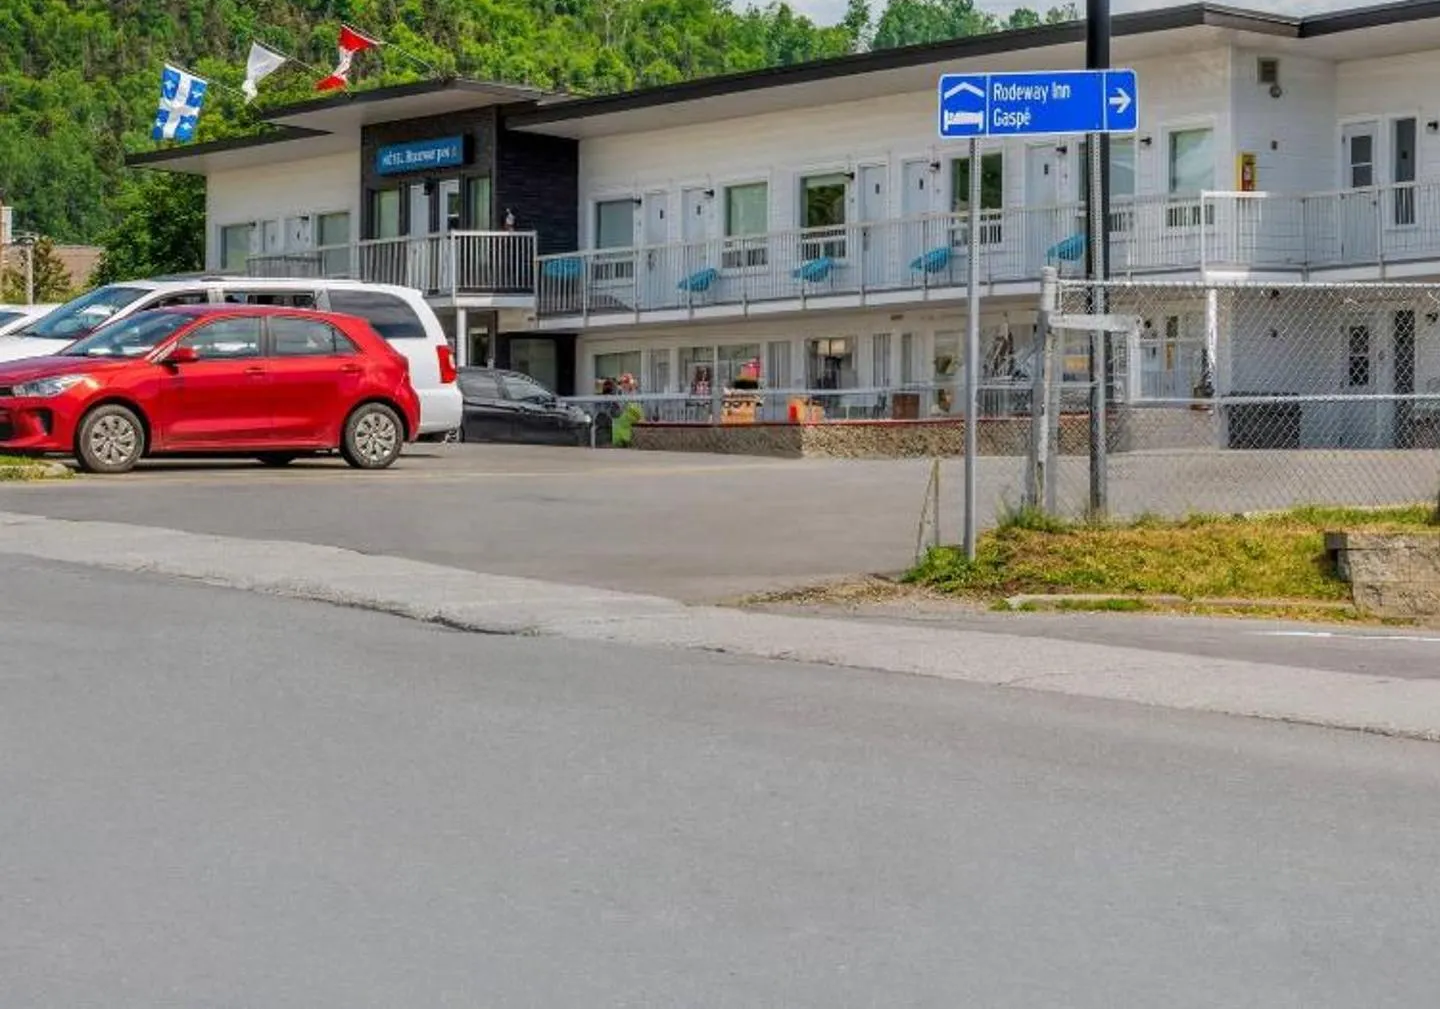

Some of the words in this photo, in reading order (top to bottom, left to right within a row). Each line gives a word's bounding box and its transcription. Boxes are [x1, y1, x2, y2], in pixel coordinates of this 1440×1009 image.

[993, 83, 1049, 103] Rodeway
[1052, 82, 1071, 99] Inn
[993, 108, 1032, 129] Gaspé
